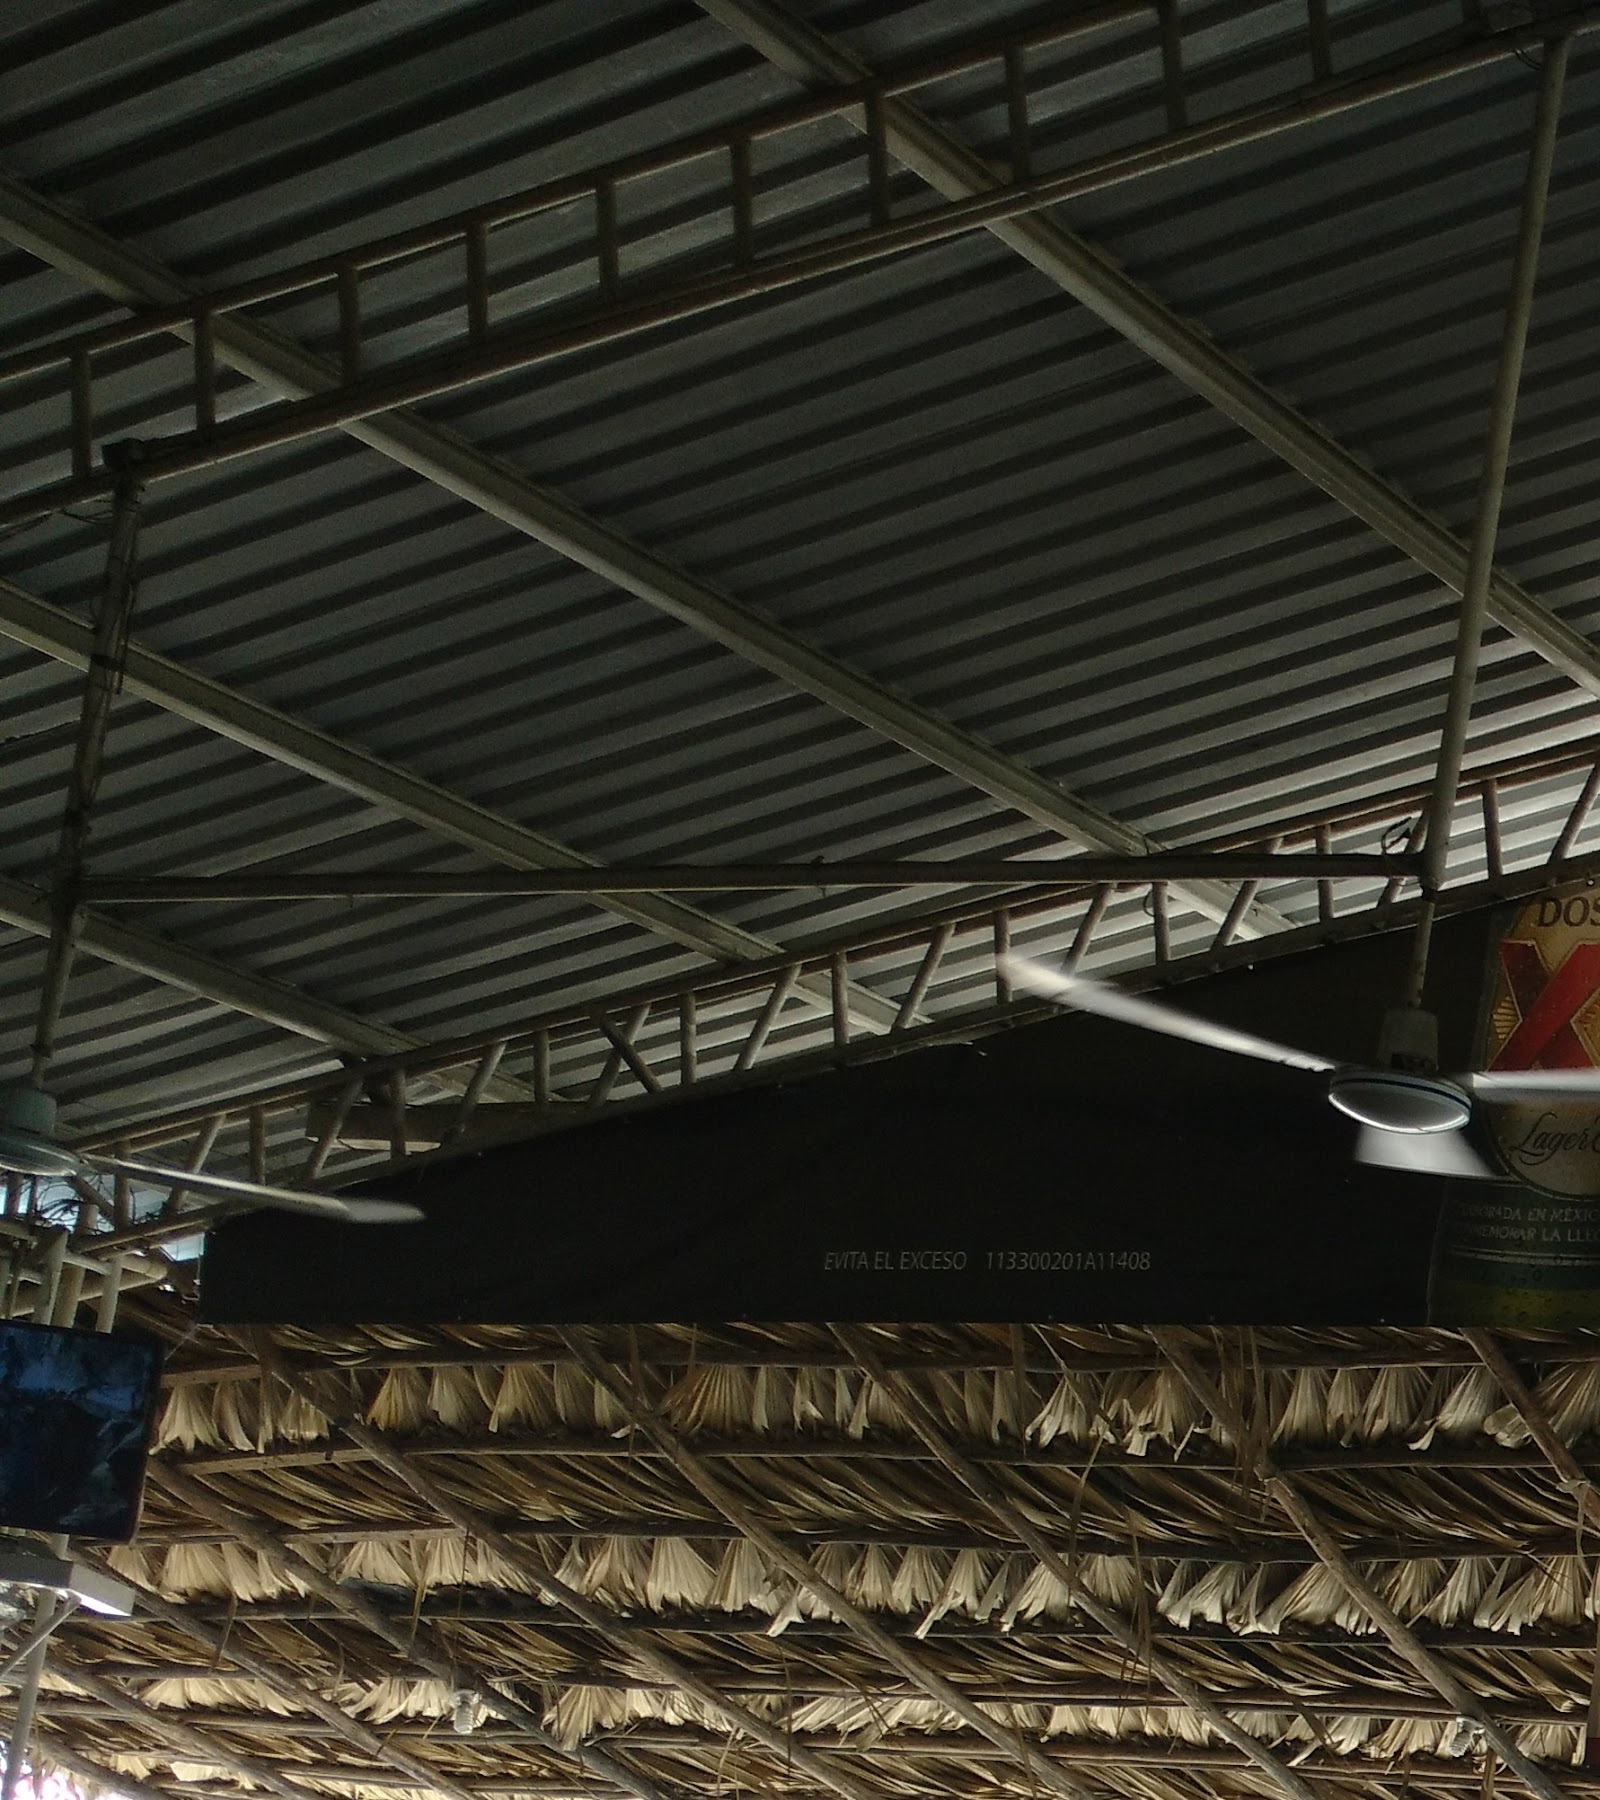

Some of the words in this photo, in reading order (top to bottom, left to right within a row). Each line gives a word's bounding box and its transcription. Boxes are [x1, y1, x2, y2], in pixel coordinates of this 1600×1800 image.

[1509, 1112, 1589, 1165] Lager
[824, 1251, 869, 1271] EVITA
[873, 1251, 895, 1270] EL
[899, 1251, 967, 1271] EXCESO
